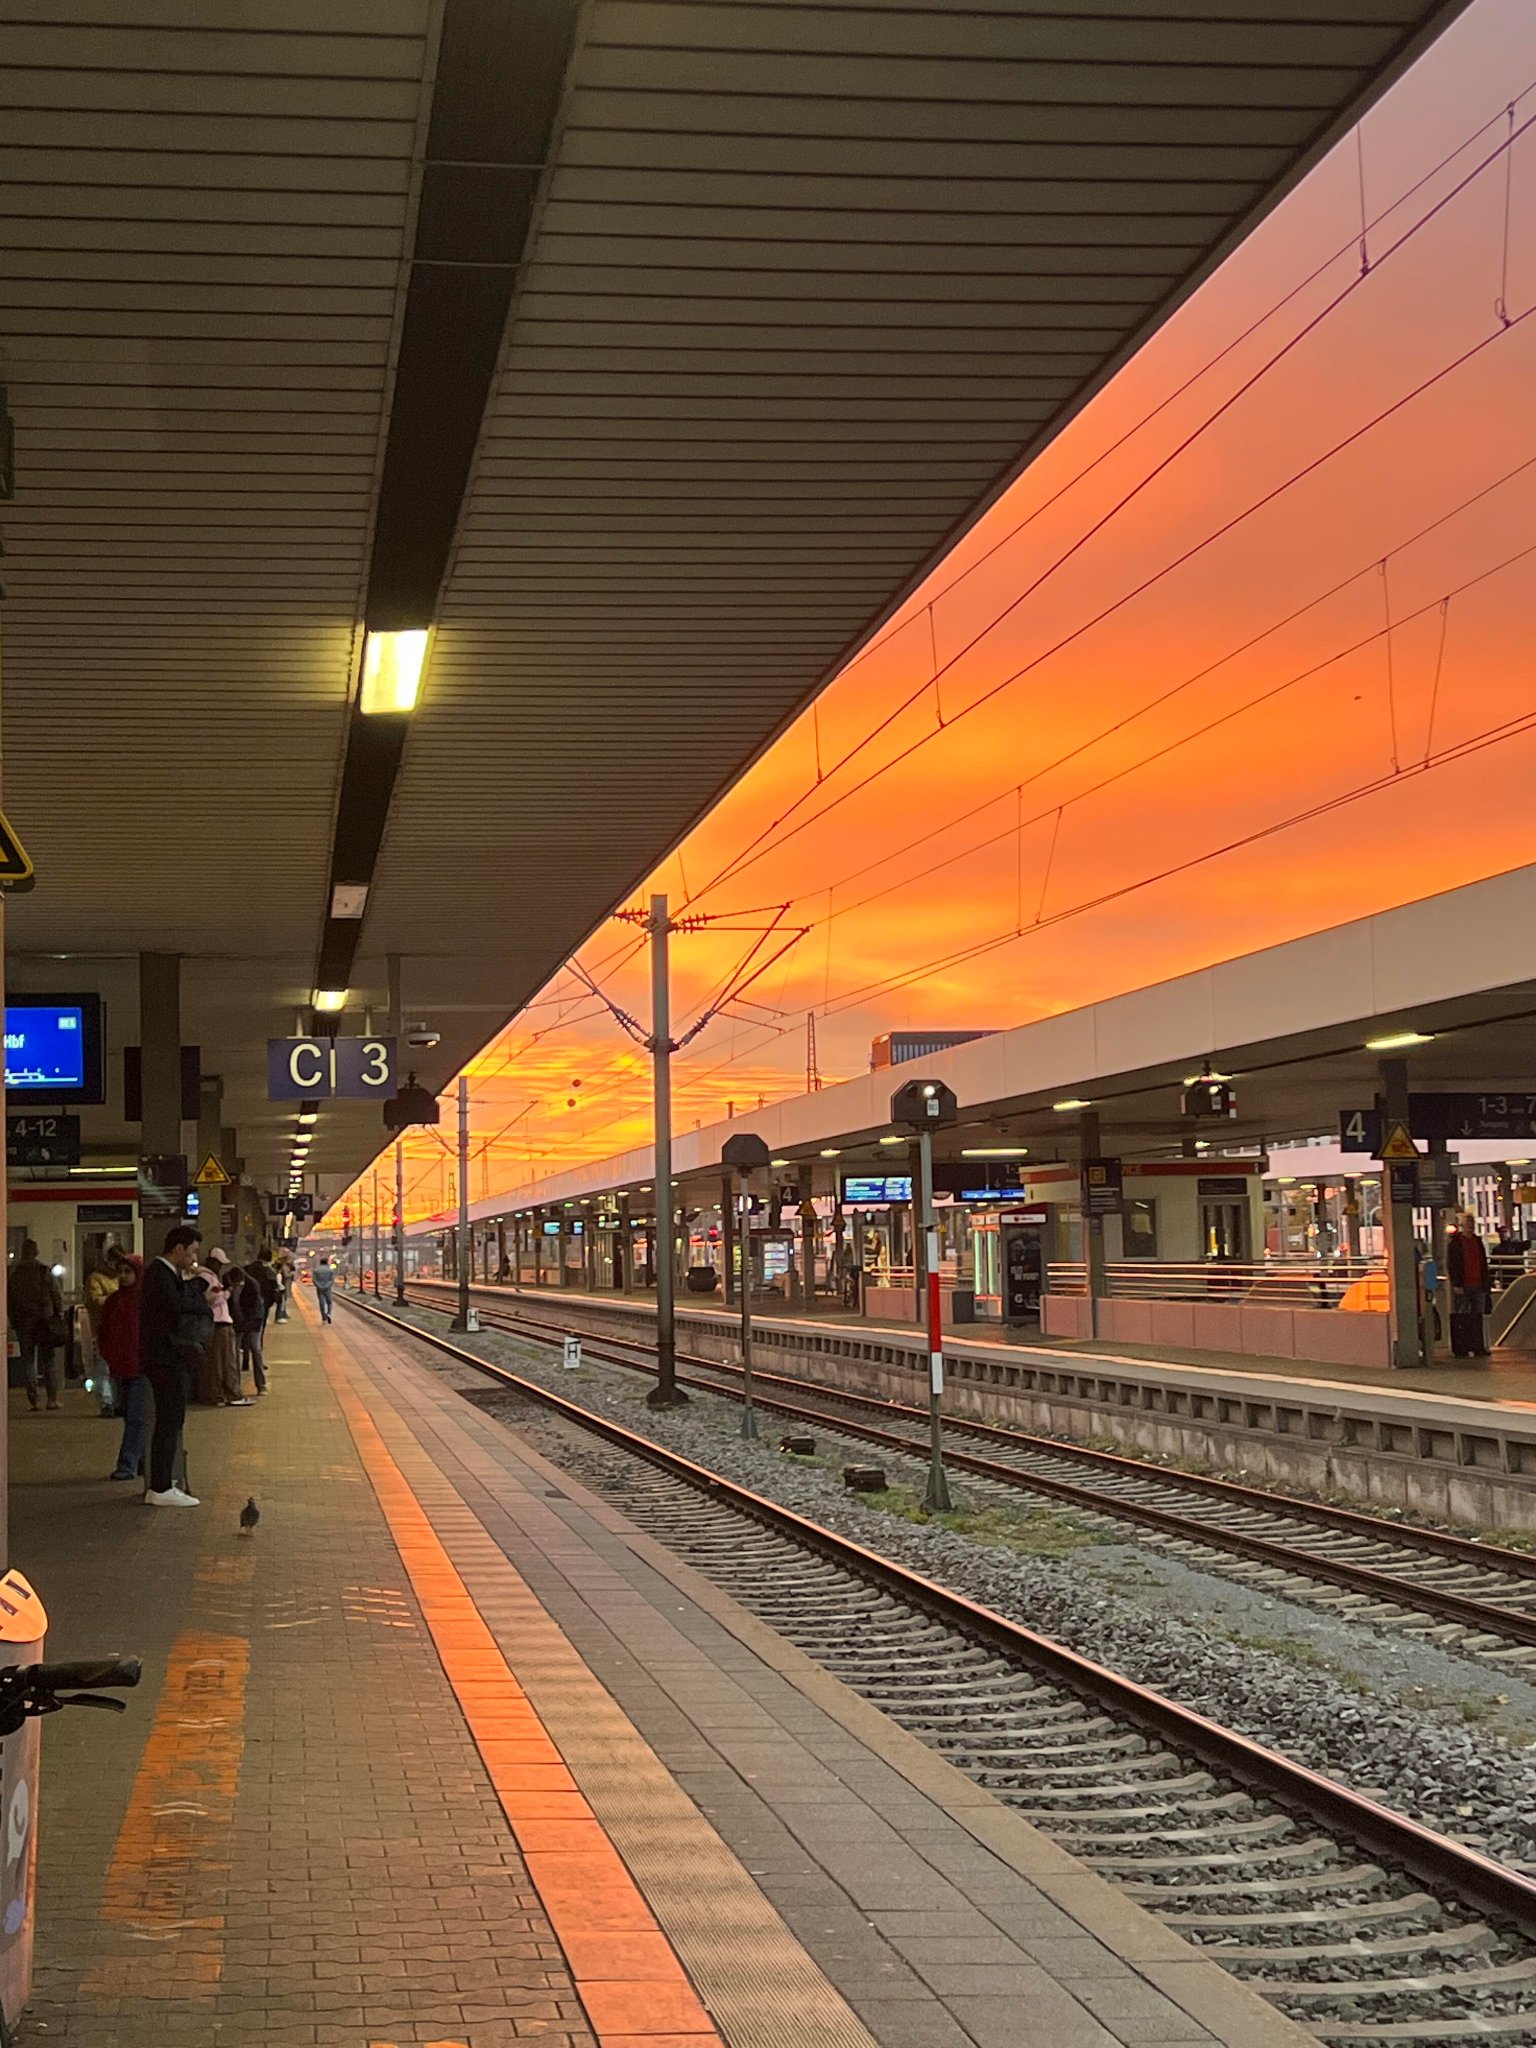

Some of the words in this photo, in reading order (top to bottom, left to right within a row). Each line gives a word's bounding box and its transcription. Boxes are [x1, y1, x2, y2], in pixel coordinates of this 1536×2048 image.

[289, 1043, 322, 1087] C
[361, 1042, 389, 1086] 3
[1479, 1096, 1507, 1115] 1-3
[1345, 1112, 1366, 1143] 4
[782, 1187, 792, 1202] 4
[275, 1197, 288, 1213] D
[567, 1343, 578, 1359] H
